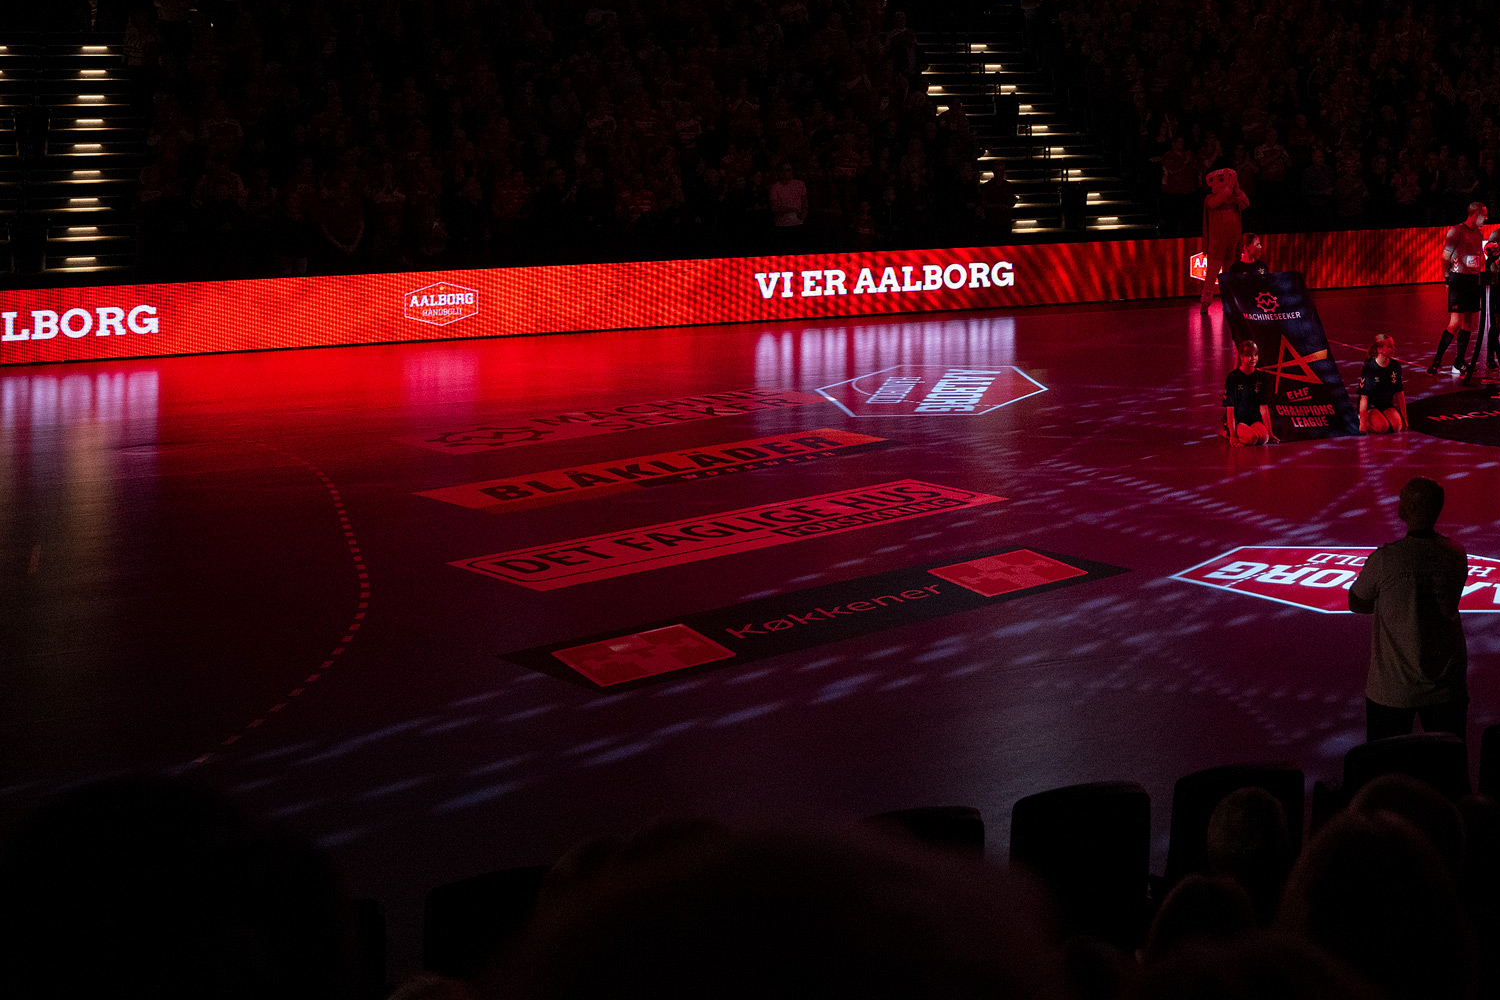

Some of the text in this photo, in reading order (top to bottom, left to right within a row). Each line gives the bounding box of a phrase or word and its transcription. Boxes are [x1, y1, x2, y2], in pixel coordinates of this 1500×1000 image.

[754, 261, 1015, 299] VI ER AALBORG
[409, 293, 474, 307] AALBORG
[1243, 311, 1302, 321] MACHINESEEKER
[1, 304, 159, 341] LBORG
[914, 368, 1002, 412] AALBORG
[1286, 387, 1310, 400] EHF
[1276, 404, 1335, 417] CHAMPIONS
[1291, 416, 1329, 428] LEAGUE
[478, 436, 844, 502] BLÅKLÄDER
[491, 485, 944, 578] DET FAGLIGE HUS
[725, 584, 942, 640] Køkkener
